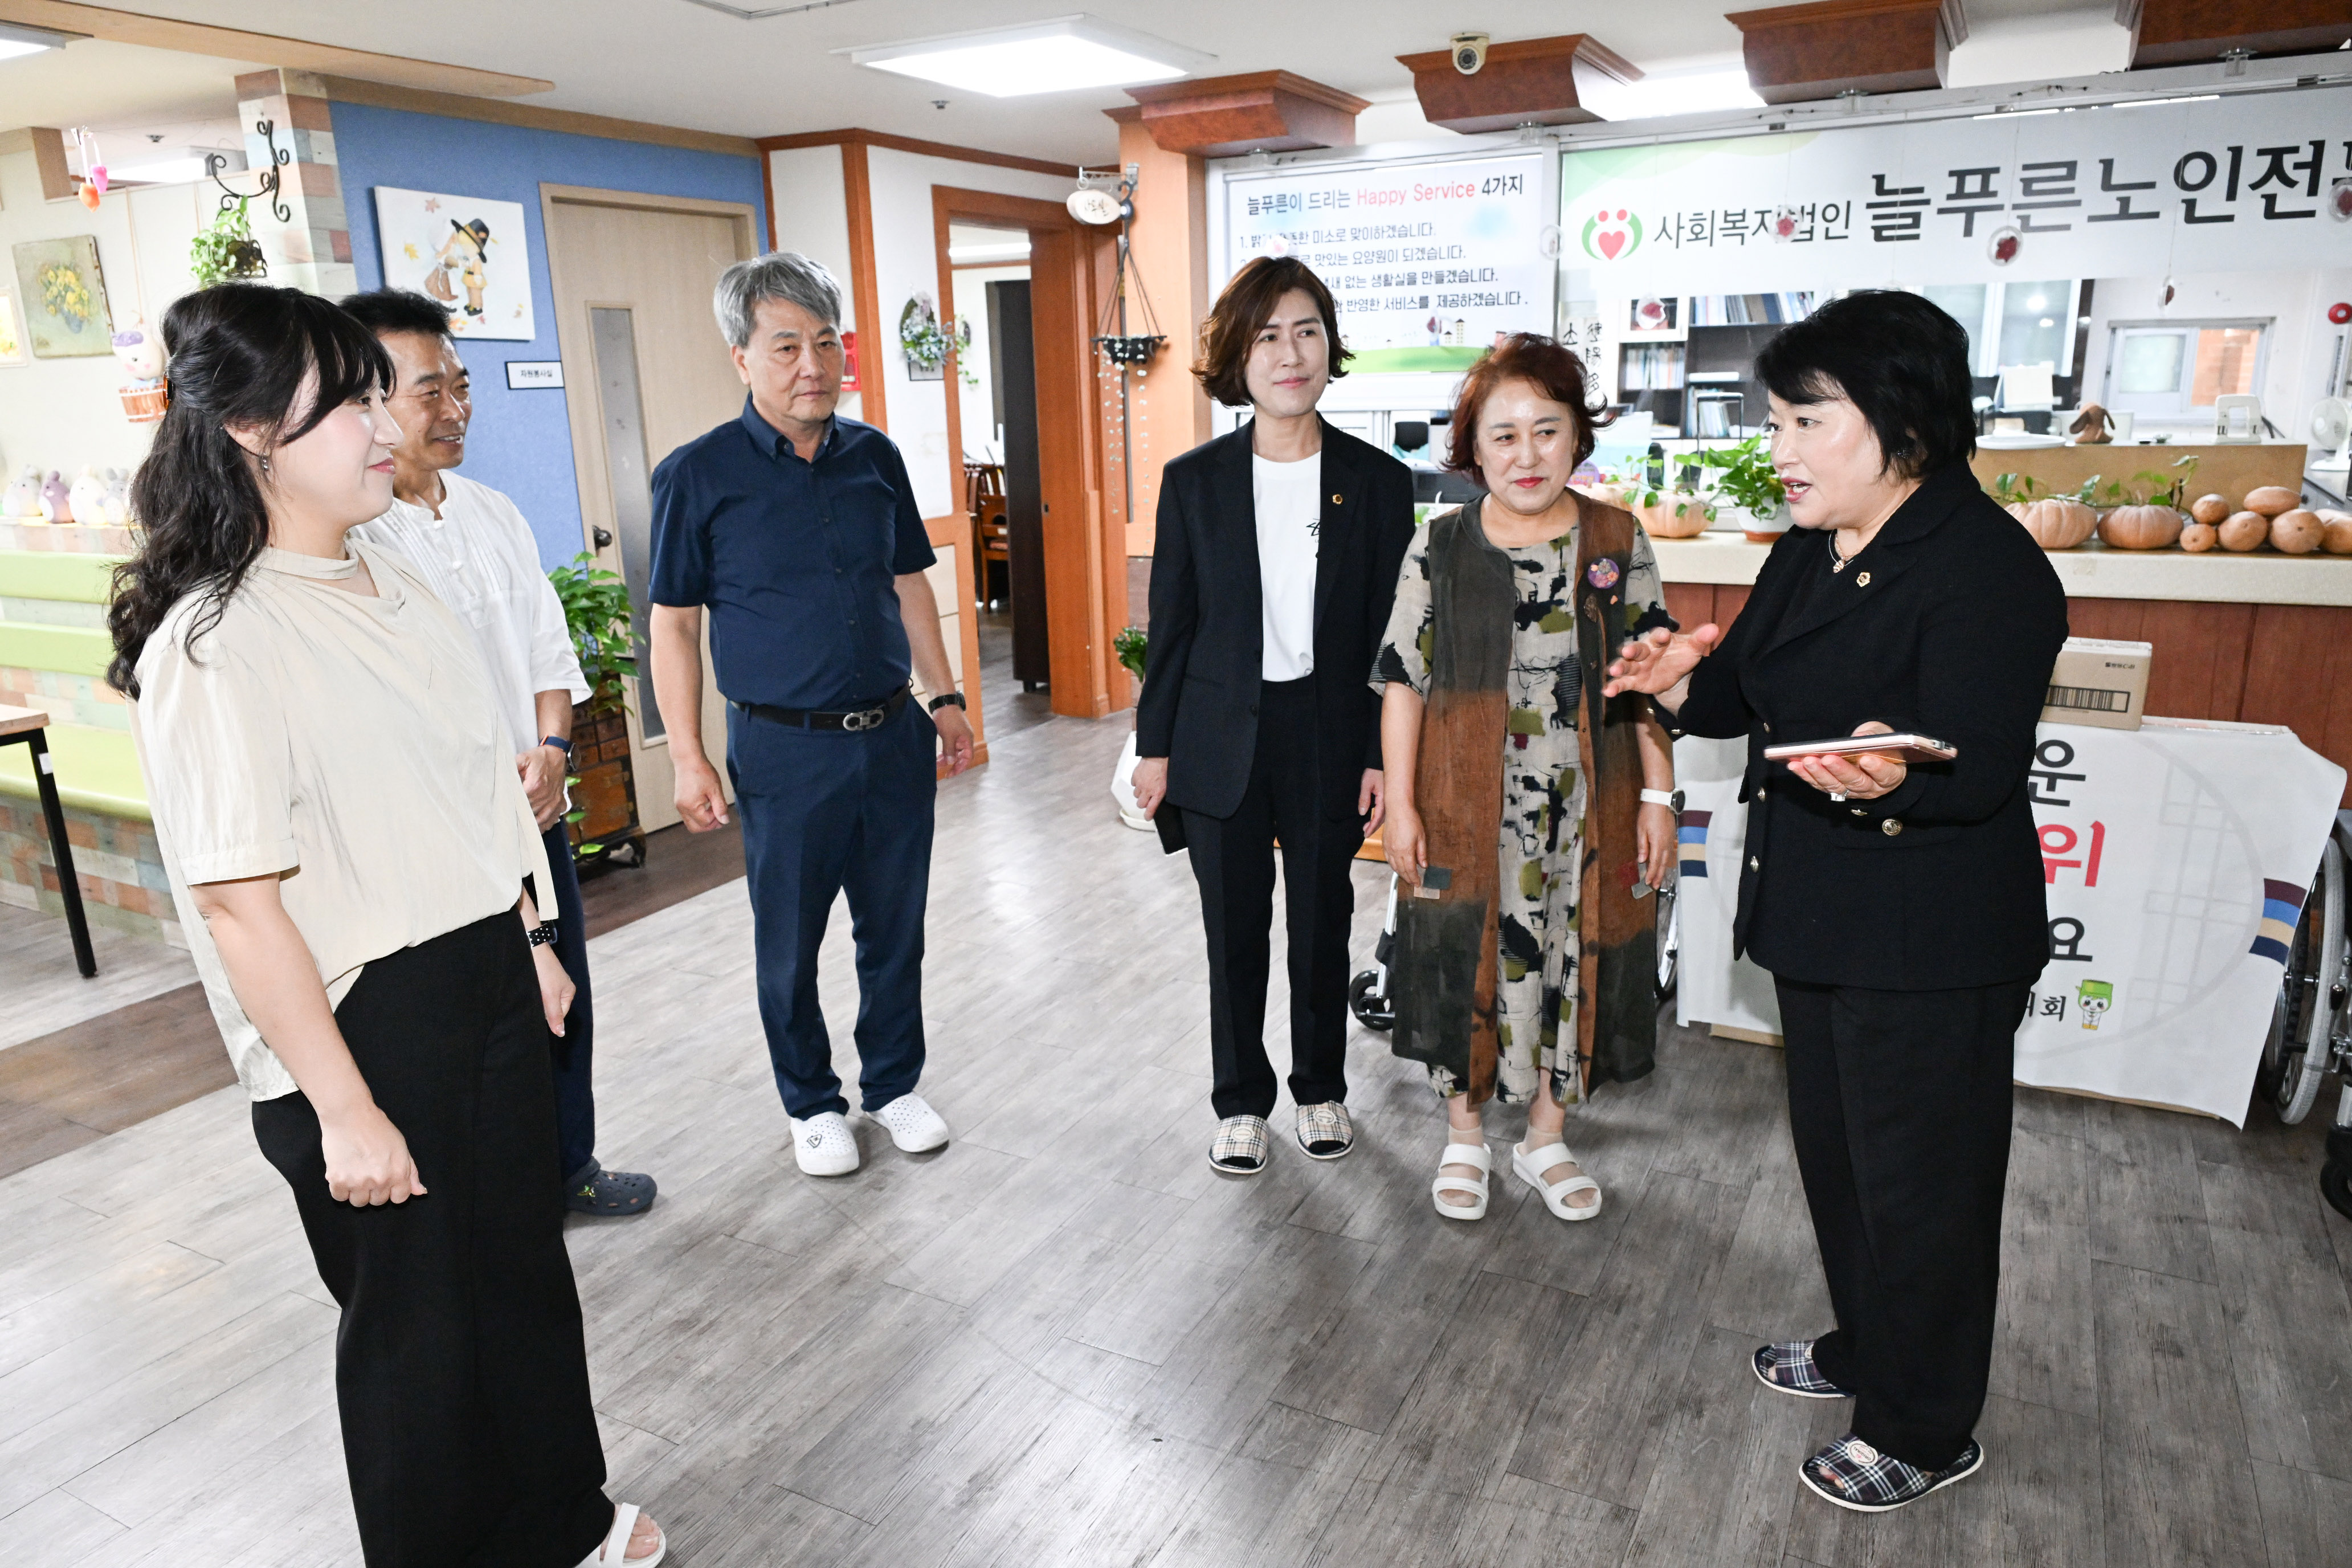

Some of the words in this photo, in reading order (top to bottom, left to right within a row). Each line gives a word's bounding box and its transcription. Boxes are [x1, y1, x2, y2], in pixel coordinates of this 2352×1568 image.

[1247, 191, 1302, 216] 늘푸른이
[1308, 189, 1350, 210] 드리는
[1357, 187, 1407, 207] Happy
[1414, 181, 1476, 202] Service
[1482, 173, 1523, 196] 4가지
[1313, 228, 1346, 243] 미소로
[1315, 252, 1348, 267] 맛있는
[1353, 249, 1398, 266] 요양원이
[1402, 244, 1466, 263] 되겠습니다.
[1345, 275, 1367, 289] 없는
[1371, 271, 1418, 288] 생활실을
[1422, 267, 1498, 285] 만들겠습니다.
[1347, 297, 1380, 313] 반영한
[1383, 295, 1430, 311] 서비스를
[1853, 1446, 1872, 1461] ORIGINAL
